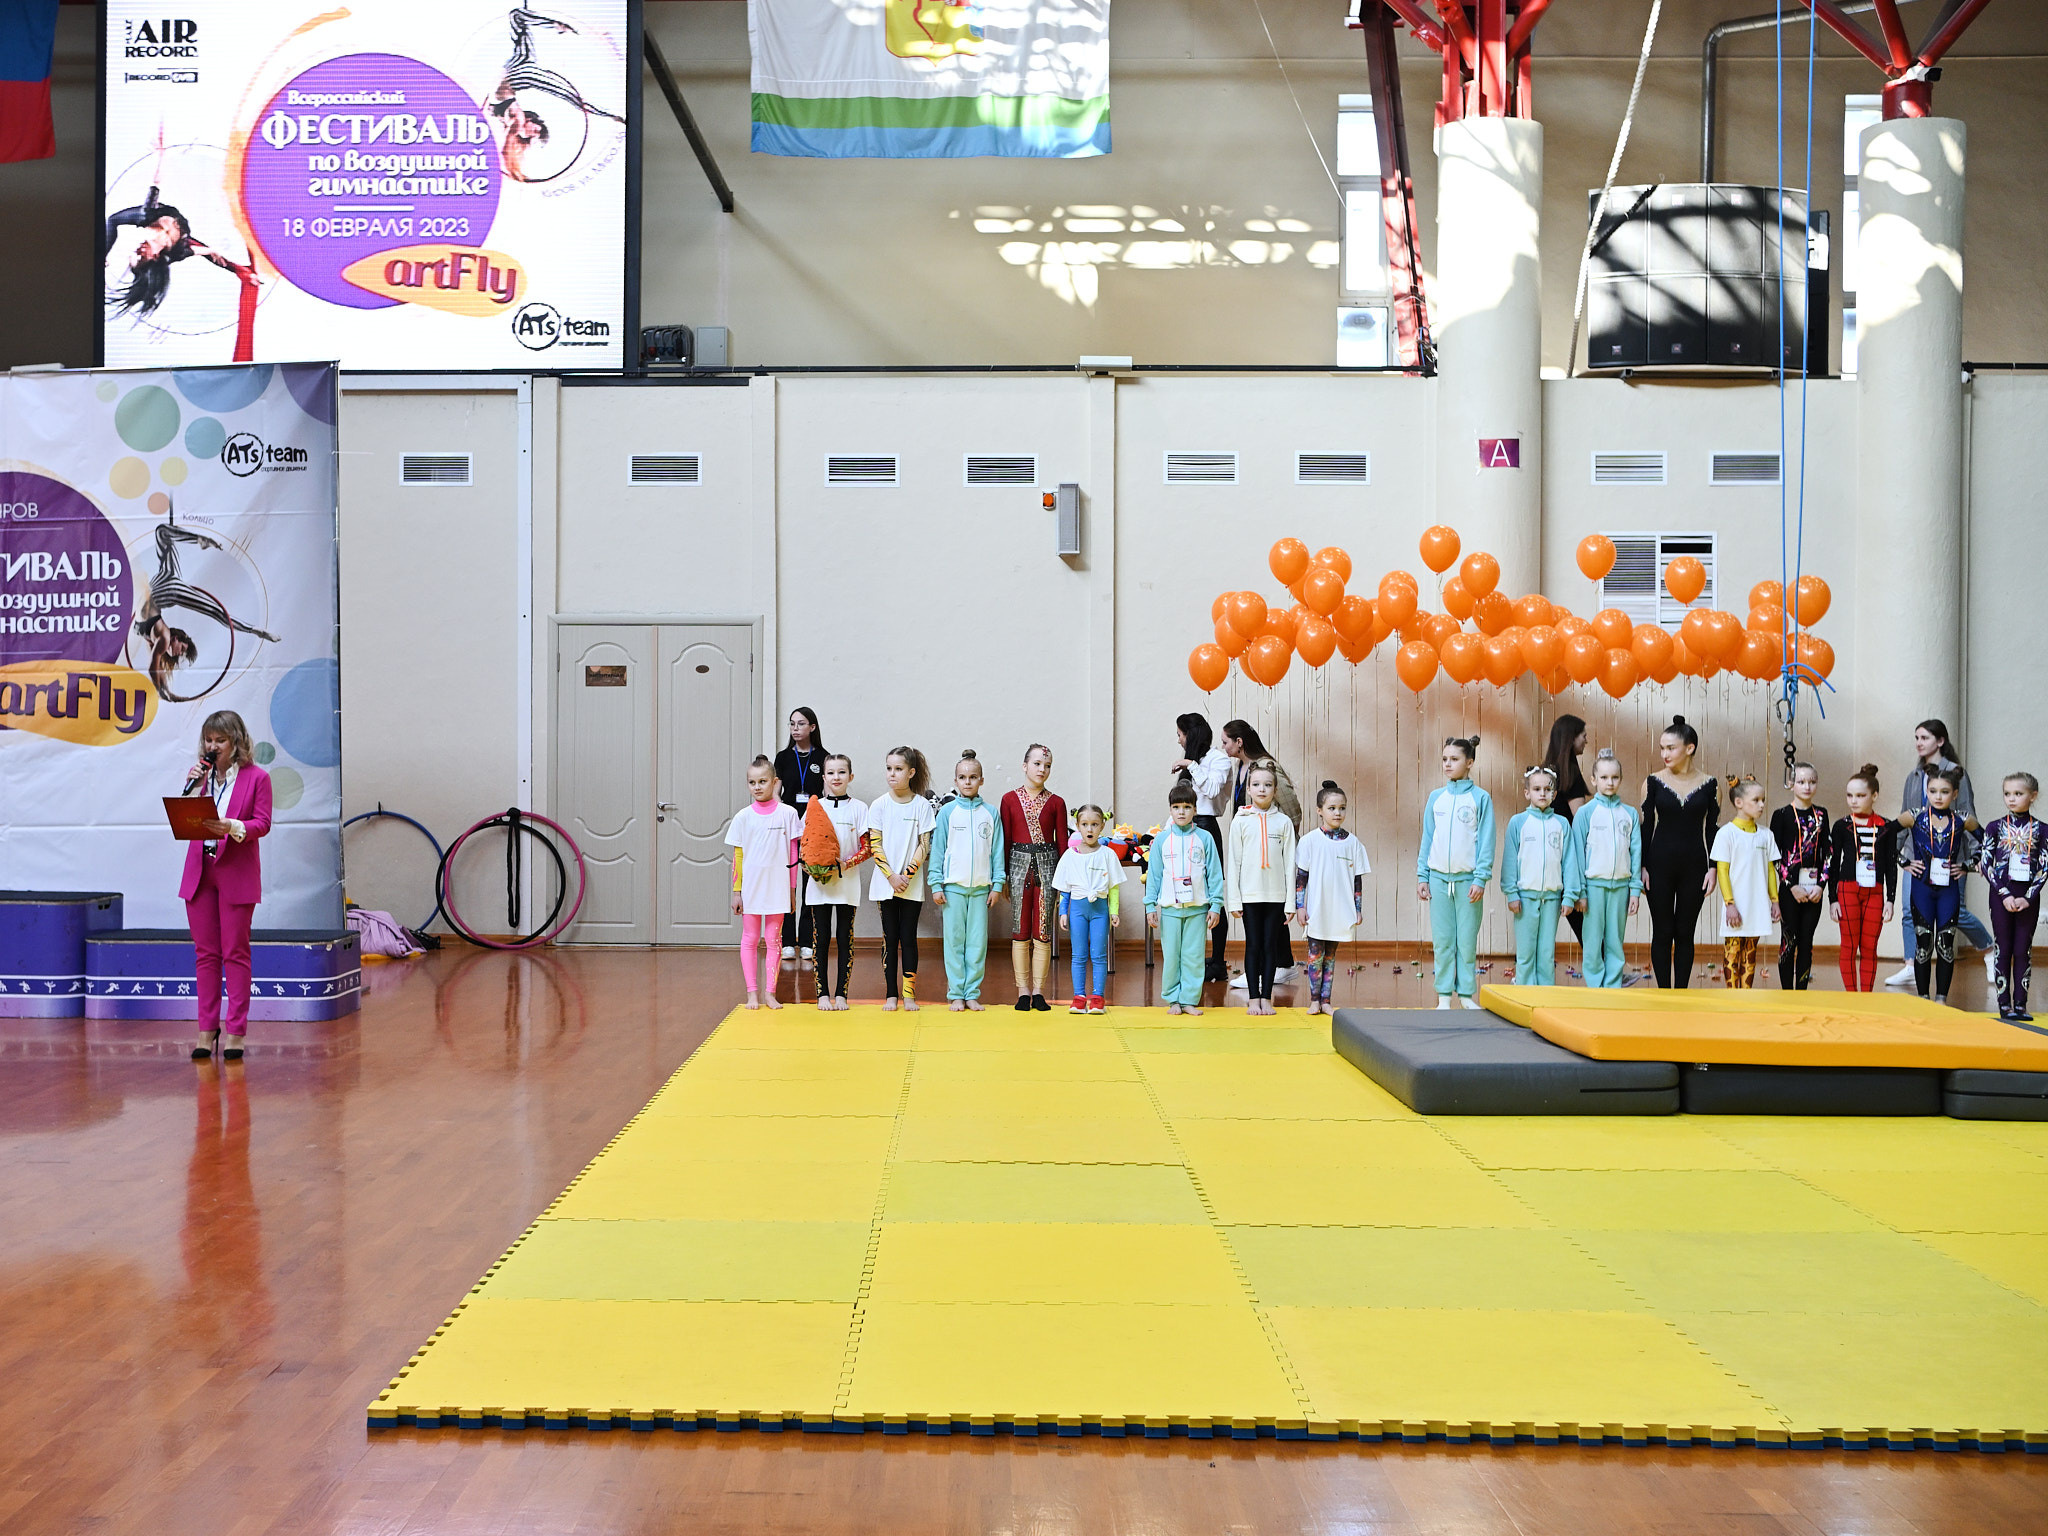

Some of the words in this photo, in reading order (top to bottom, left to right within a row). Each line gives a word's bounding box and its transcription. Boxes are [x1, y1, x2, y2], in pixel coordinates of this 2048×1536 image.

[134, 19, 198, 44] AIR
[125, 46, 199, 57] RECORD
[287, 89, 407, 107] Всероссийский
[261, 110, 490, 149] ФЕСТИВАЛЬ
[308, 154, 341, 171] по
[344, 149, 489, 176] воздушной
[308, 171, 490, 197] гимнастике
[282, 217, 306, 238] 18
[310, 217, 414, 238] ФЕВРАЛЯ
[418, 217, 470, 238] 2023
[383, 252, 517, 304] artFly
[563, 317, 610, 336] team
[265, 444, 309, 463] team
